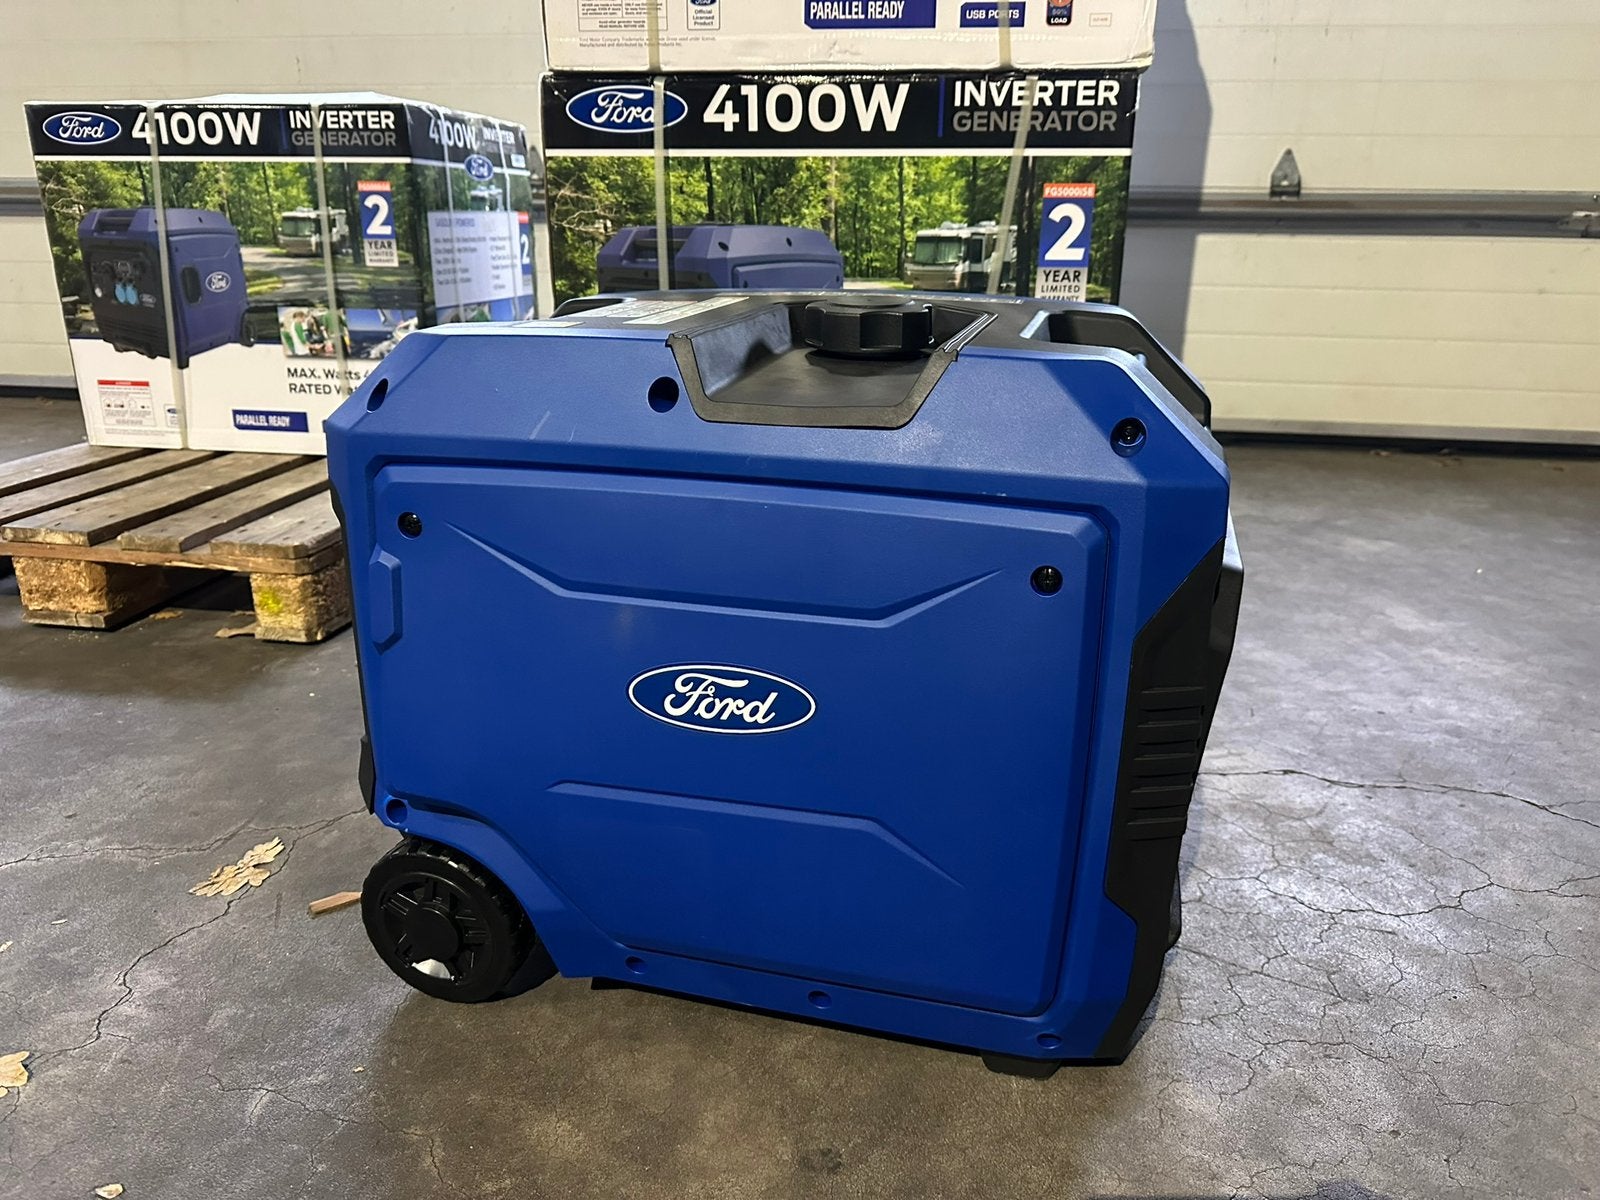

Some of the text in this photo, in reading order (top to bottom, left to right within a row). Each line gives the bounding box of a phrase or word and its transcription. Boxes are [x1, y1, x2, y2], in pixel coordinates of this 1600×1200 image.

[810, 1, 905, 20] PARALLEL READY
[966, 9, 986, 19] USB
[954, 80, 1121, 107] INVERTER
[703, 83, 910, 132] 4100W
[58, 111, 262, 146] Ford 4100W
[288, 110, 396, 129] INVERTER
[953, 110, 1118, 132] GENERATOR
[291, 131, 397, 146] GENERATOR
[363, 194, 393, 235] 2
[1044, 203, 1086, 261] 2
[367, 241, 393, 250] YEAR
[520, 233, 531, 265] 2
[1043, 270, 1081, 284] YEAR
[1041, 285, 1081, 293] LIMITED
[287, 367, 321, 379] MAX.
[289, 383, 332, 395] RATED
[235, 414, 290, 427] PARALLEL READY
[663, 672, 779, 724] Ford
